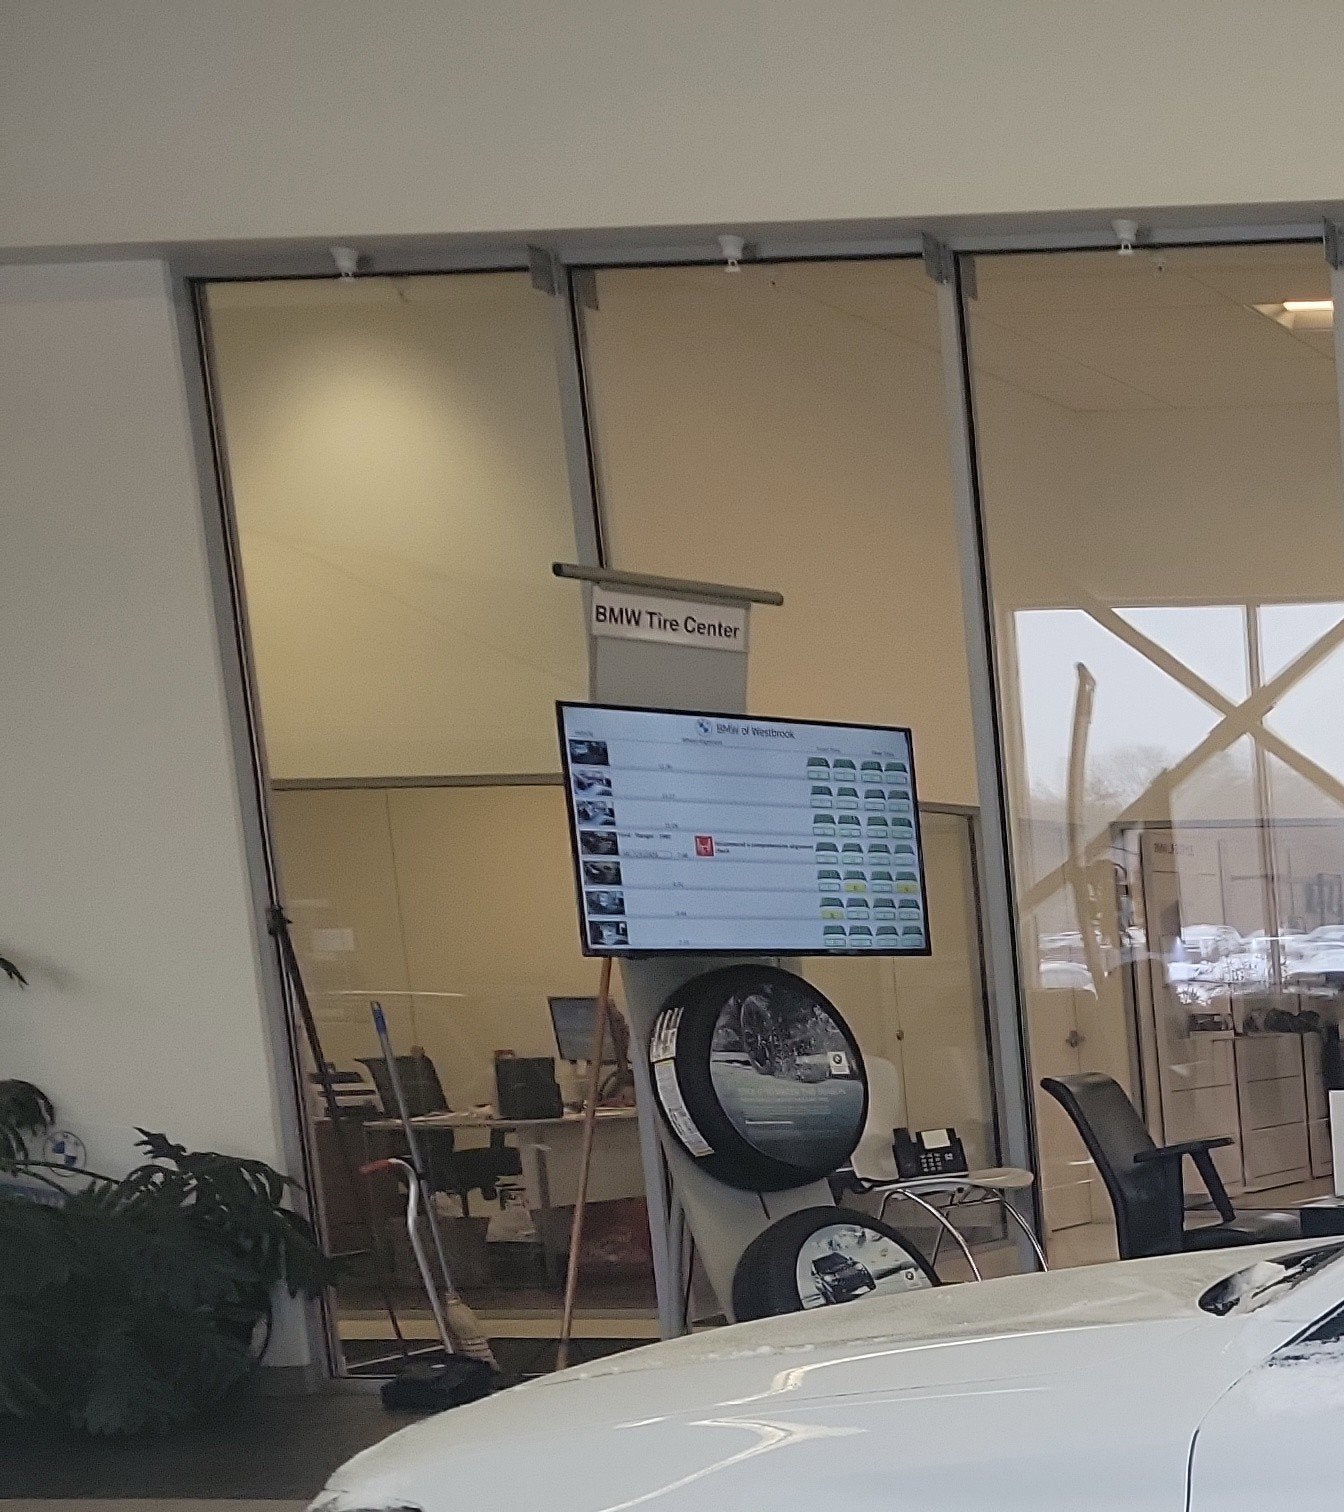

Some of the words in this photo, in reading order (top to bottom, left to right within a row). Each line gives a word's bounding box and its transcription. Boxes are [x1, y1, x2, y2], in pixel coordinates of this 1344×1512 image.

[595, 605, 642, 627] BMW
[646, 611, 679, 631] Tire
[684, 616, 740, 638] Center
[741, 726, 749, 736] of
[751, 726, 796, 739] Westbrook
